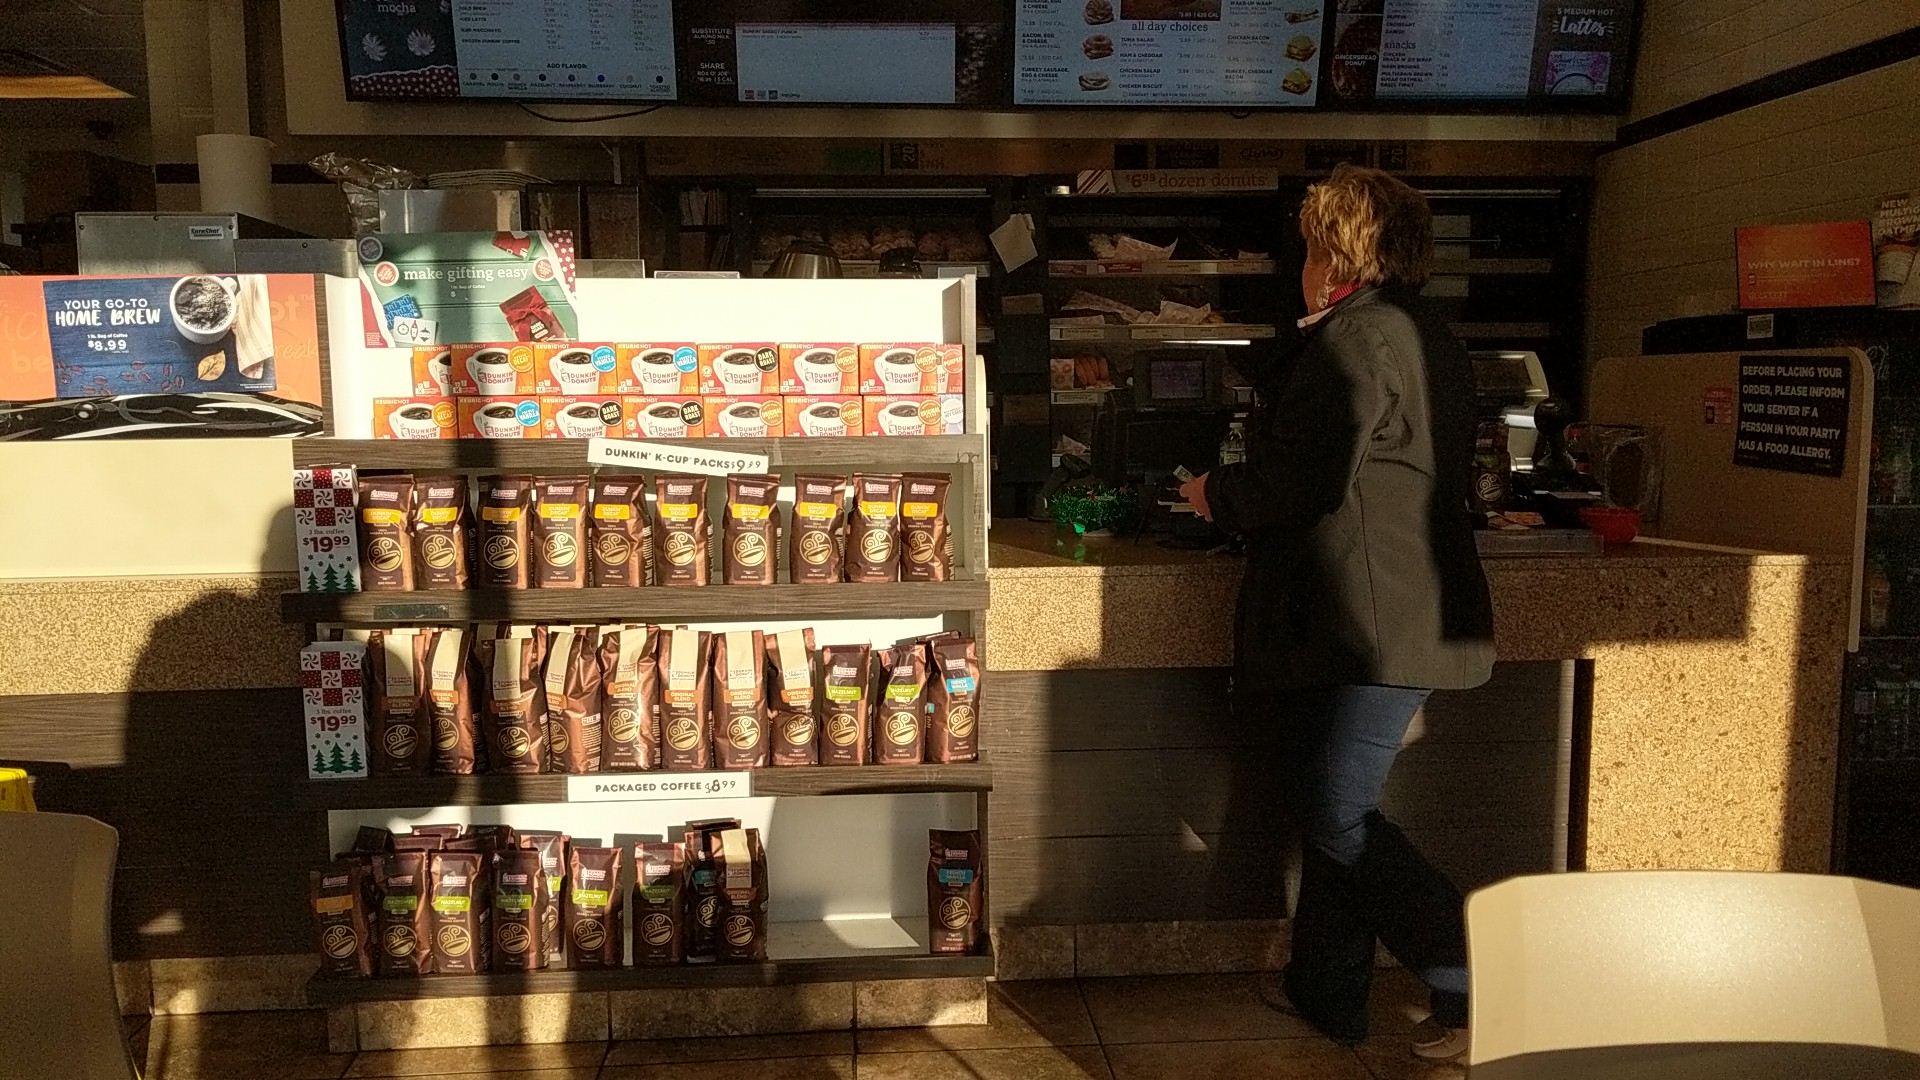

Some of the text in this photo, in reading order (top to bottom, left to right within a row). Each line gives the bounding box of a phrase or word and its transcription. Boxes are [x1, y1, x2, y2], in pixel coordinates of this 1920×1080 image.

[378, 2, 416, 13] mocha
[1132, 22, 1208, 33] all day choices
[1560, 16, 1607, 36] Lattes
[1384, 41, 1416, 49] snacks
[1158, 173, 1207, 188] dozen
[1211, 172, 1266, 187] donuts
[1881, 199, 1908, 209] NEW
[1778, 260, 1809, 268] WAIT
[1828, 258, 1860, 266] LINE?
[404, 268, 443, 280] make
[447, 266, 493, 282] gifting
[497, 267, 528, 280] easy
[64, 298, 148, 310] YOUR GO-TO
[55, 308, 160, 326] HOME BREW
[88, 340, 126, 351] $8.99
[513, 356, 530, 364] DECAF
[758, 351, 773, 360] DARK
[759, 357, 775, 367] ROAST
[1743, 366, 1842, 378] BEFORE PLACING YOUR
[1743, 385, 1845, 398] ORDER, PLEASE INFORM
[602, 405, 617, 414] DARK
[683, 405, 698, 415] DARK
[1743, 403, 1818, 418] YOUR SERVER IF A
[437, 412, 453, 421] DECAF
[604, 411, 620, 421] ROAST
[685, 411, 701, 420] ROAST
[1741, 422, 1840, 440] PERSON IN YOUR PARTY
[1739, 440, 1831, 459] HAS A FOOD ALLERGY.
[605, 448, 651, 460] DUNKIN'
[655, 454, 689, 464] K-CUP
[693, 458, 730, 468] PACKS
[595, 784, 656, 792] PACKAGED
[660, 782, 702, 791] COFFEE
